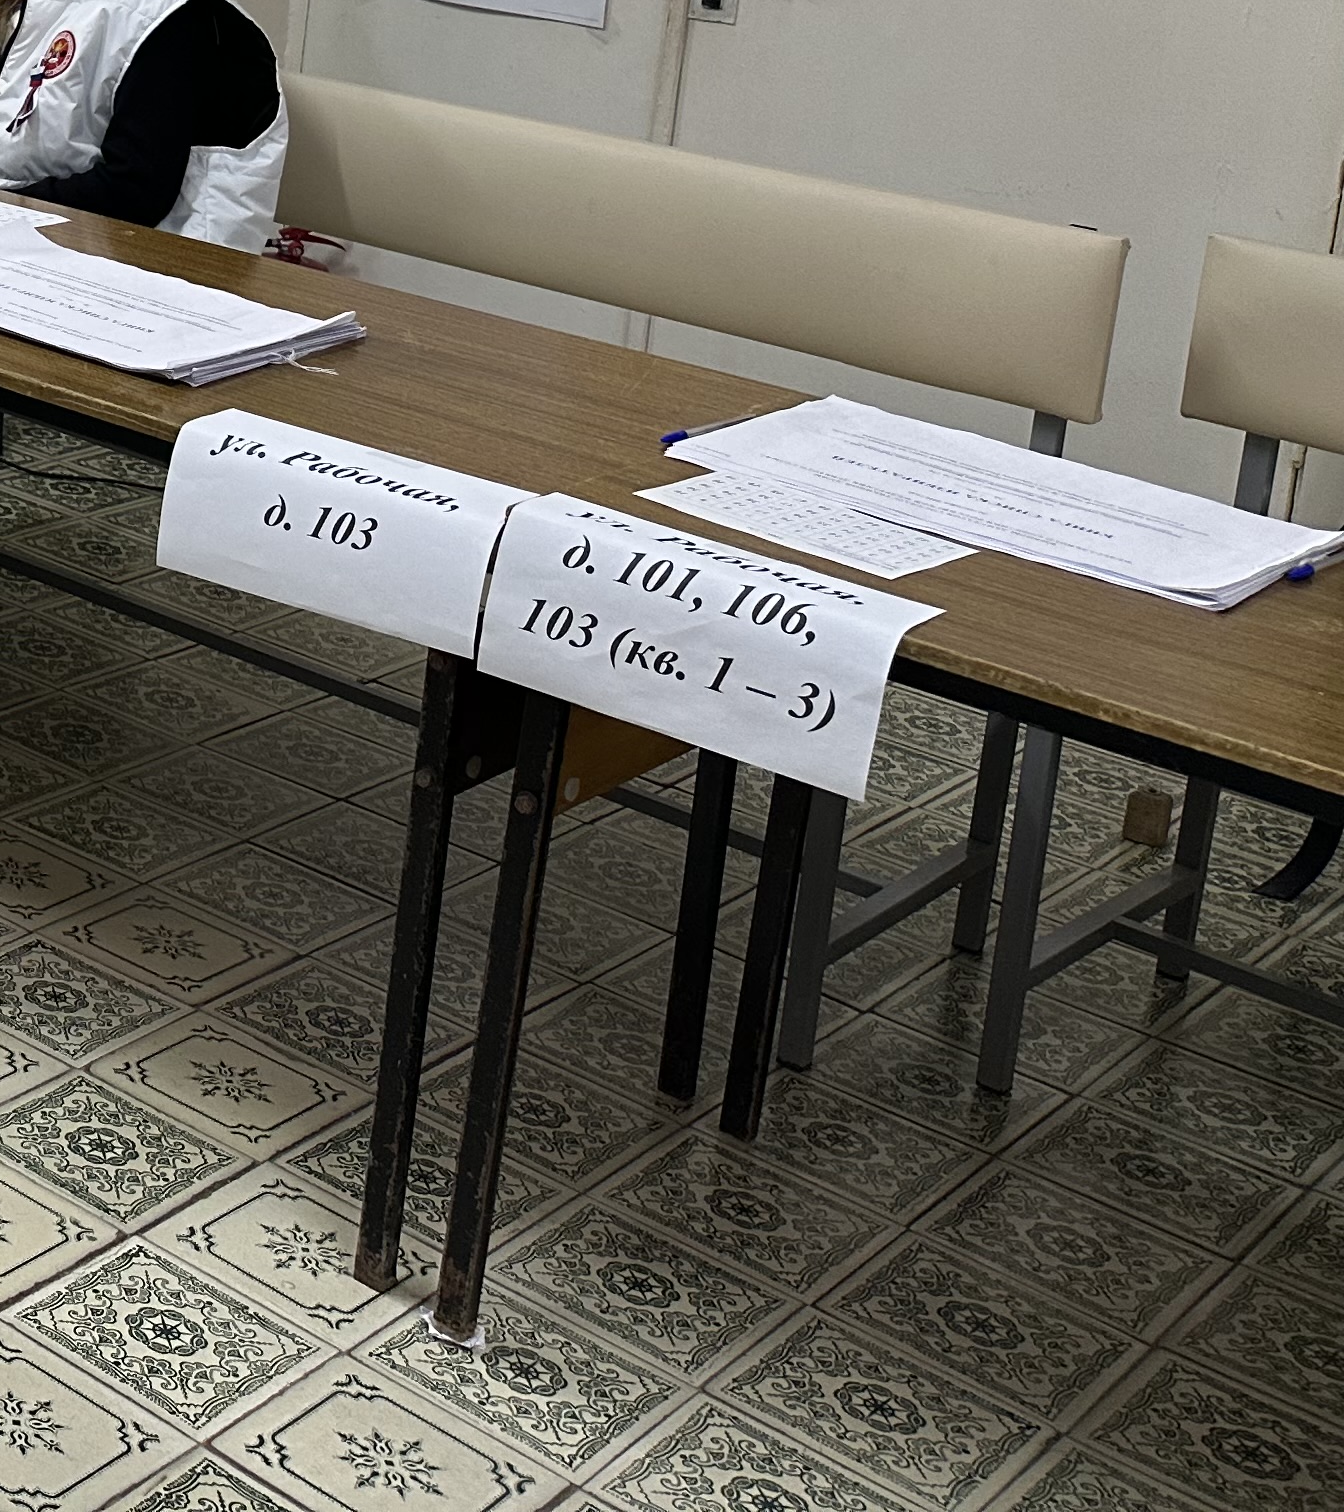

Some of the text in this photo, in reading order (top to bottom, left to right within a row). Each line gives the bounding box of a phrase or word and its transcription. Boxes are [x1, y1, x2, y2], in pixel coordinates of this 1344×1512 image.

[209, 434, 460, 512] ул. Рабочая,
[264, 493, 379, 550] д. 103
[565, 511, 634, 533] ул.
[653, 536, 864, 605] Рабочая,
[562, 534, 818, 647] д. 101, 106,
[518, 598, 599, 648] 103
[609, 627, 686, 670] (кв.
[704, 656, 735, 694] 1
[787, 682, 836, 733] 3)
